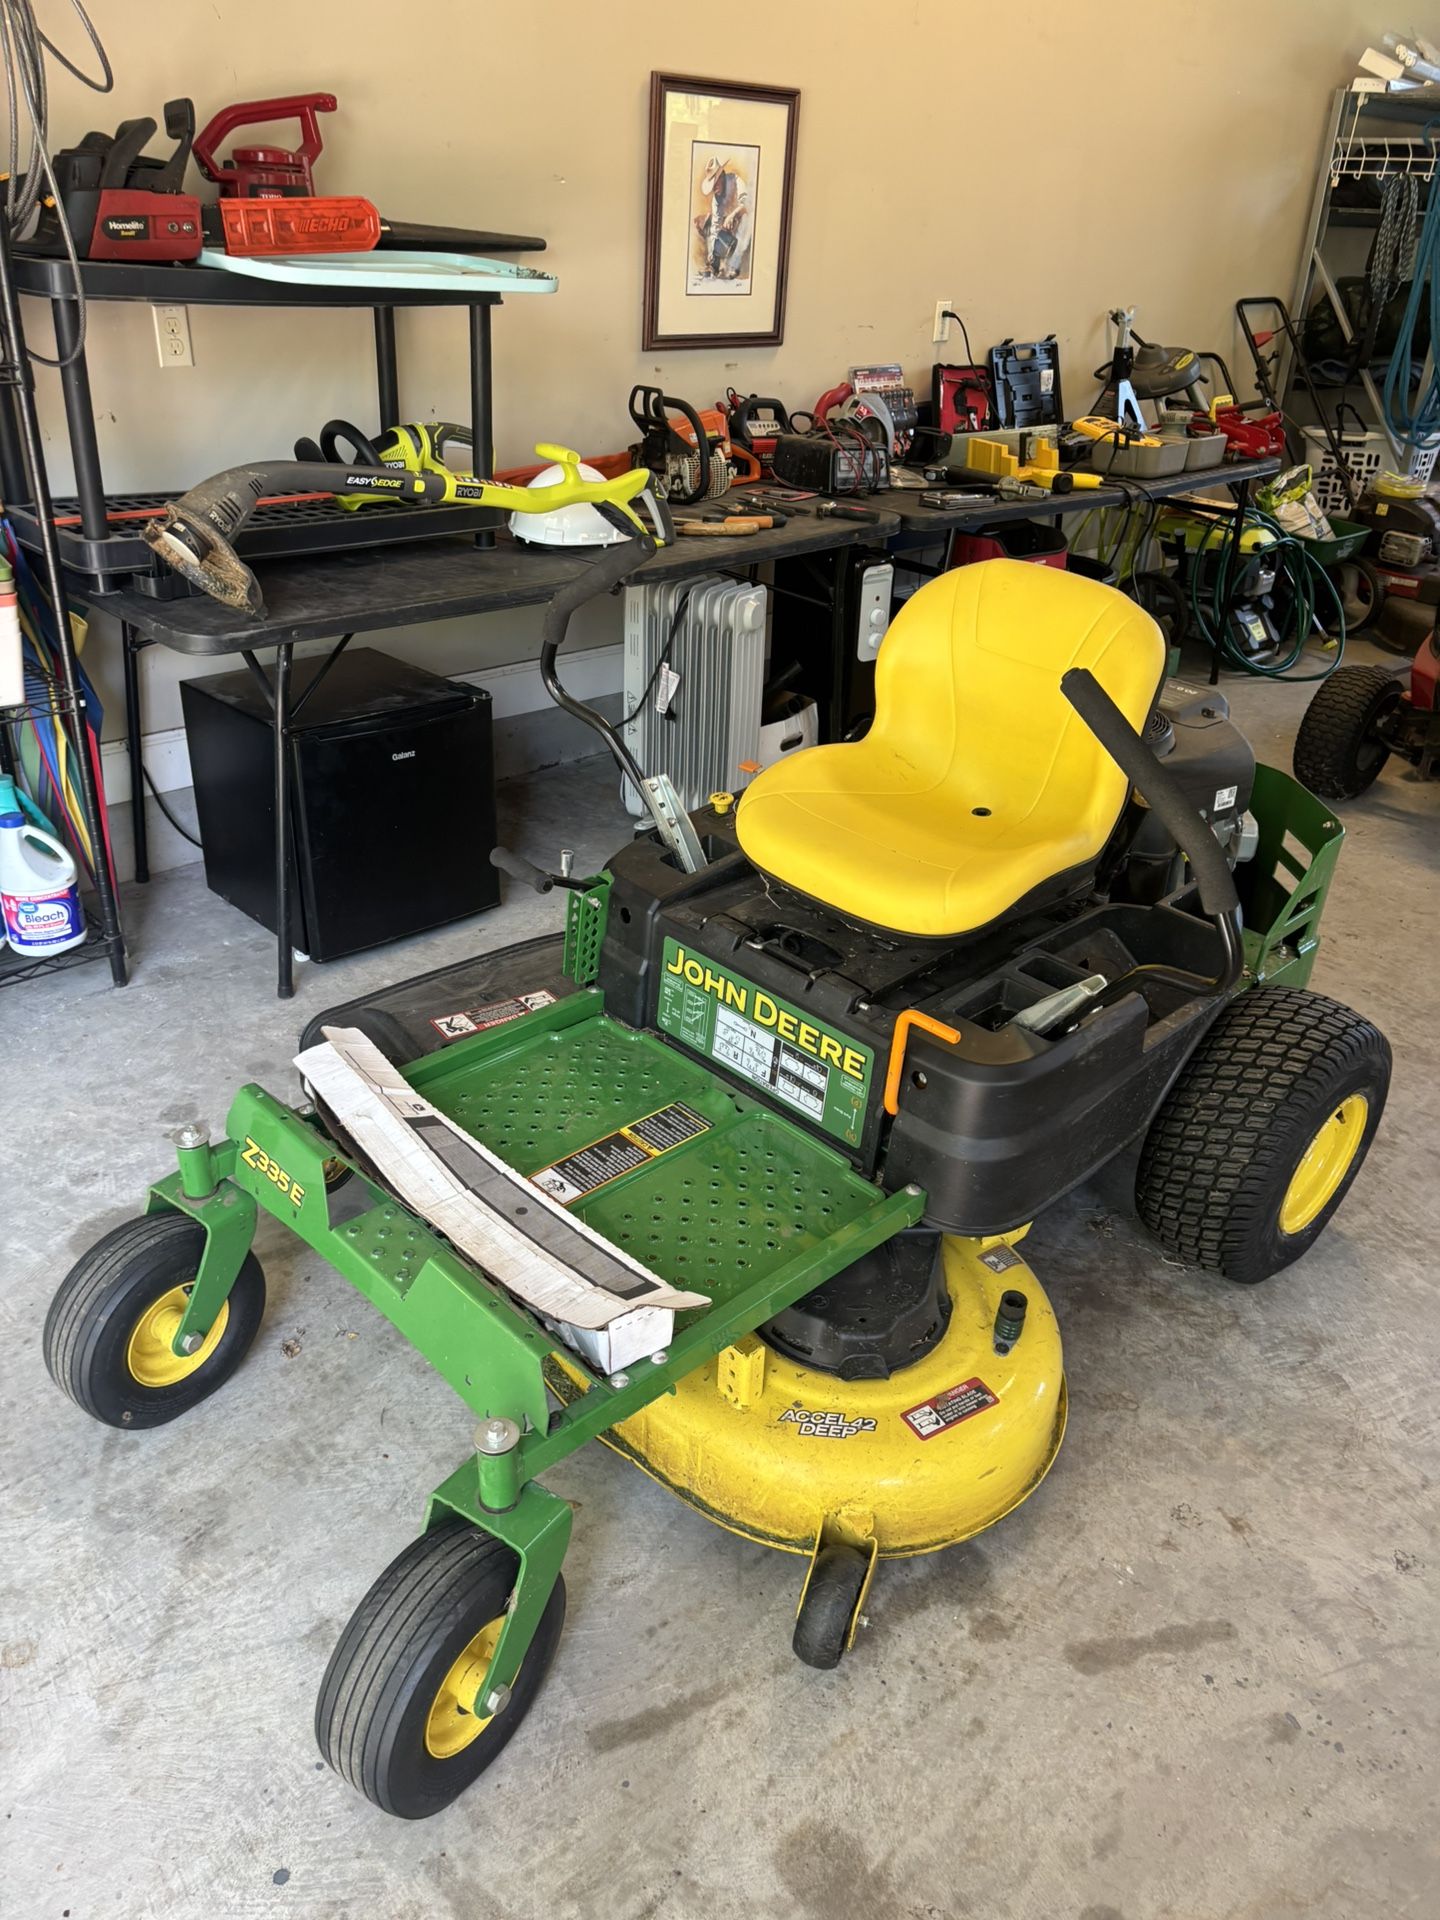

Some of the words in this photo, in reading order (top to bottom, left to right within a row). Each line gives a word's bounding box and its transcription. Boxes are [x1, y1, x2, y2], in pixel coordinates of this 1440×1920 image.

[108, 220, 145, 231] Homelite
[311, 217, 348, 233] ECHO
[346, 476, 372, 485] EASY
[377, 478, 404, 488] EDGE
[456, 487, 482, 498] RYOBI
[25, 910, 65, 923] Bleach
[667, 947, 748, 1013] JOHN
[753, 991, 866, 1081] DEERE
[779, 1409, 850, 1427] ACCEL
[849, 1417, 878, 1432] 42
[799, 1422, 858, 1438] DEEP
